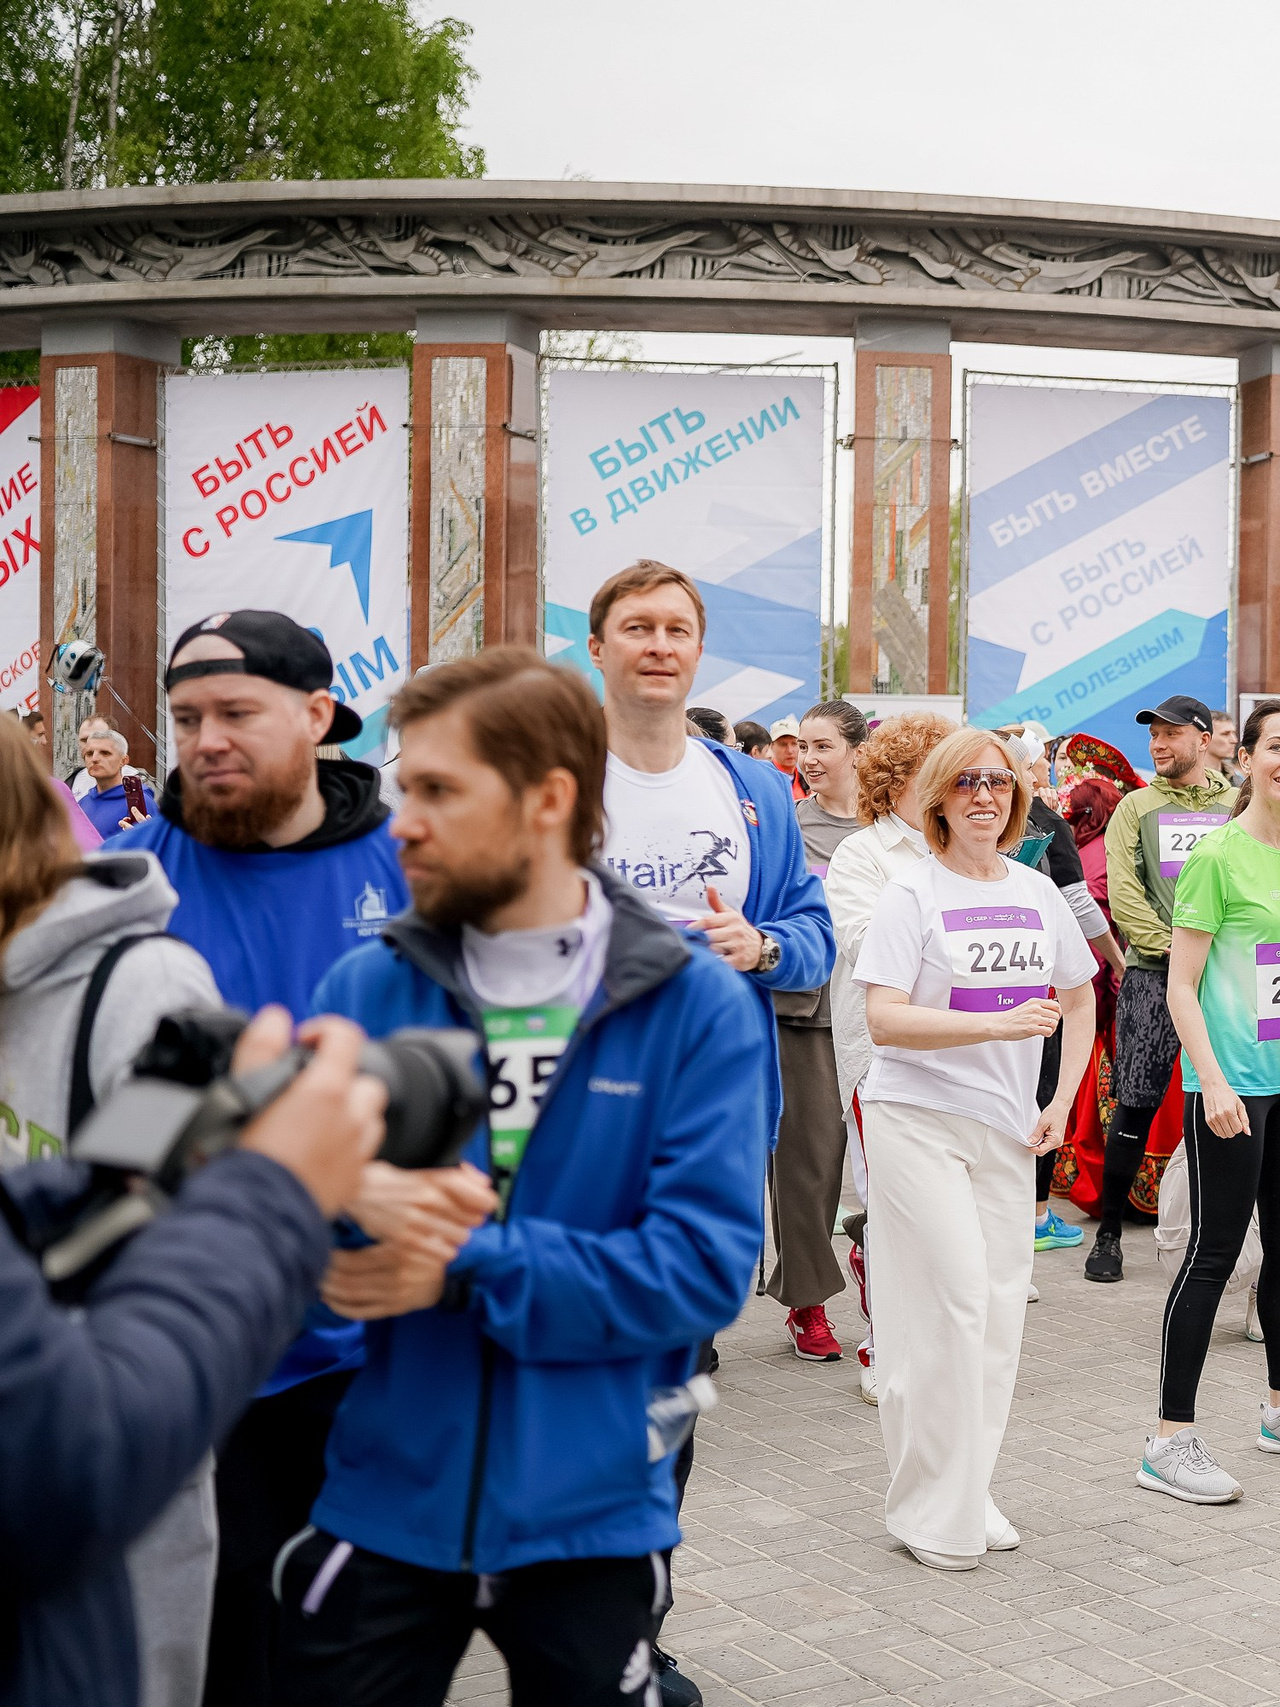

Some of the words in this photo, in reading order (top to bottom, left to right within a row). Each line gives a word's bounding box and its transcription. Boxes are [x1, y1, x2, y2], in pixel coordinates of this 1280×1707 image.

[182, 527, 210, 559] С
[215, 402, 389, 539] РОССИЕЙ
[191, 421, 294, 499] БЫТЬ
[570, 507, 598, 536] В
[604, 396, 801, 524] ДВИЖЕНИИ
[589, 406, 706, 480] БЫТЬ
[987, 488, 1077, 548] БЫТЬ
[1078, 414, 1208, 499] ВМЕСТЕ
[1030, 620, 1054, 647] С
[1057, 534, 1205, 632] РОССИЕЙ
[1060, 536, 1147, 595] БЫТЬ
[1054, 626, 1186, 711] ПОЛЕЗНЫМ
[1171, 833, 1208, 851] 22
[968, 941, 1044, 973] 2244
